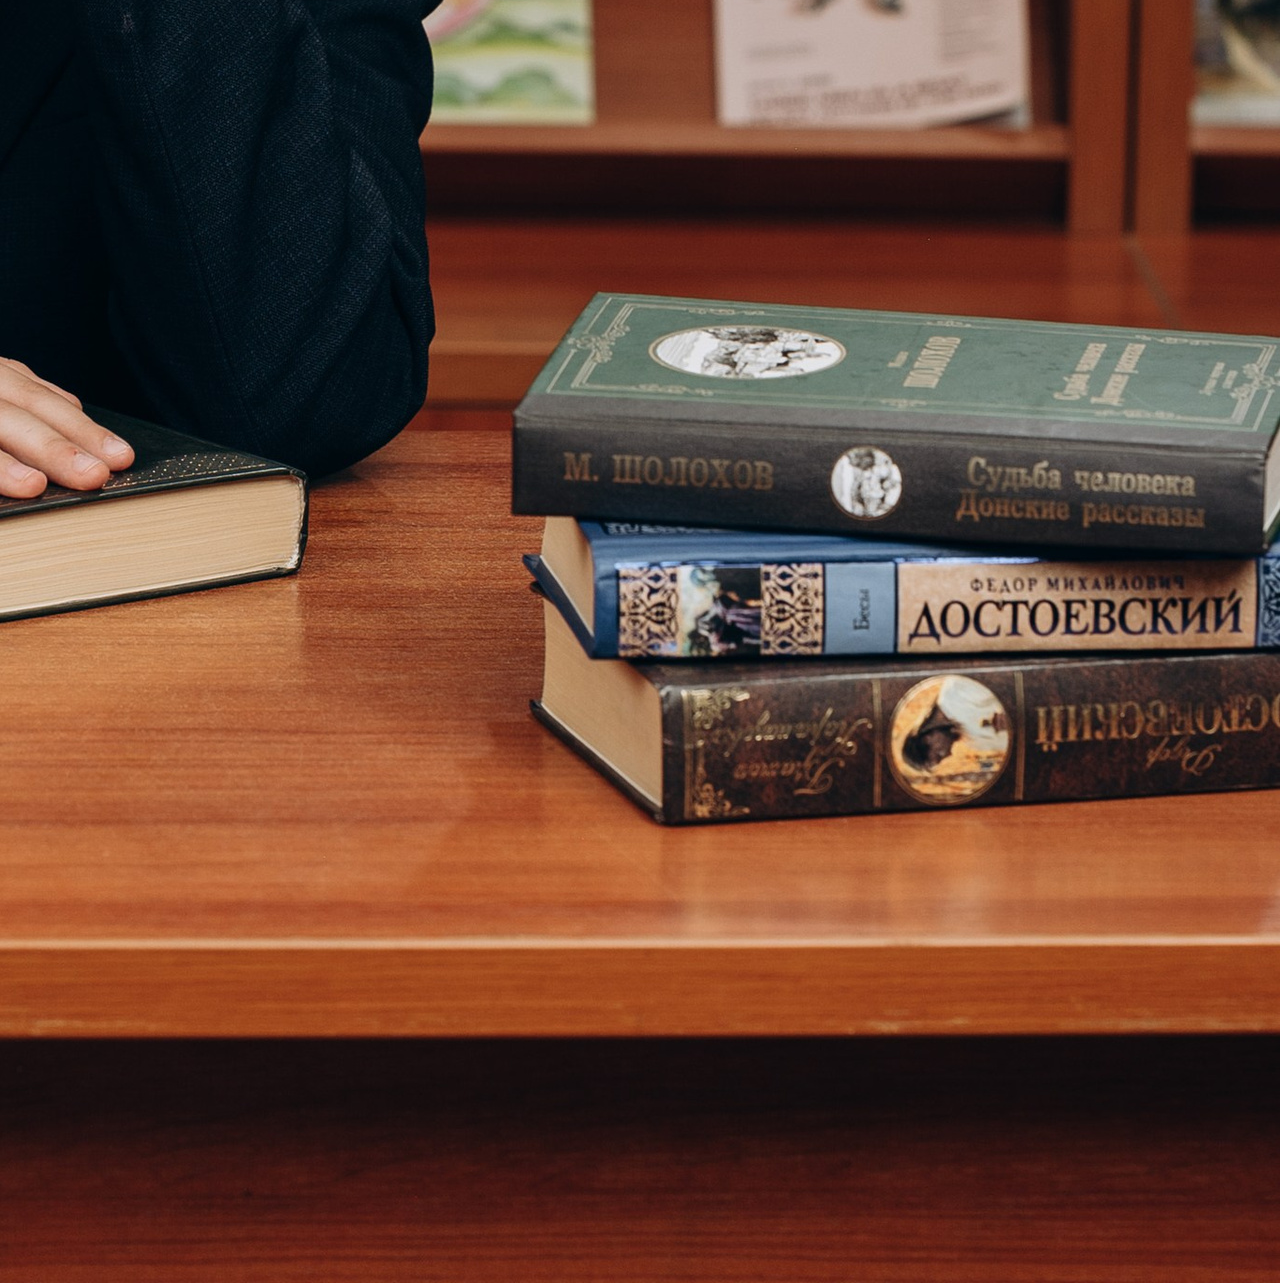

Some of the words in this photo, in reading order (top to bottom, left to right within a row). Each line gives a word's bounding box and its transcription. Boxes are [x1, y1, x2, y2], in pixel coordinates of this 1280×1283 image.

[563, 451, 600, 483] М.
[611, 453, 775, 492] ШОЛОХОВ
[966, 455, 1062, 493] Судьба
[1073, 469, 1197, 498] человека
[955, 489, 1071, 522] Донские
[1082, 499, 1207, 530] рассказы
[970, 576, 1038, 595] ФЕДОР
[1046, 573, 1186, 593] МИХАЙЛОВИЧ
[852, 587, 870, 632] Бесы
[907, 587, 1245, 646] ДОСТОЕВСКИЙ
